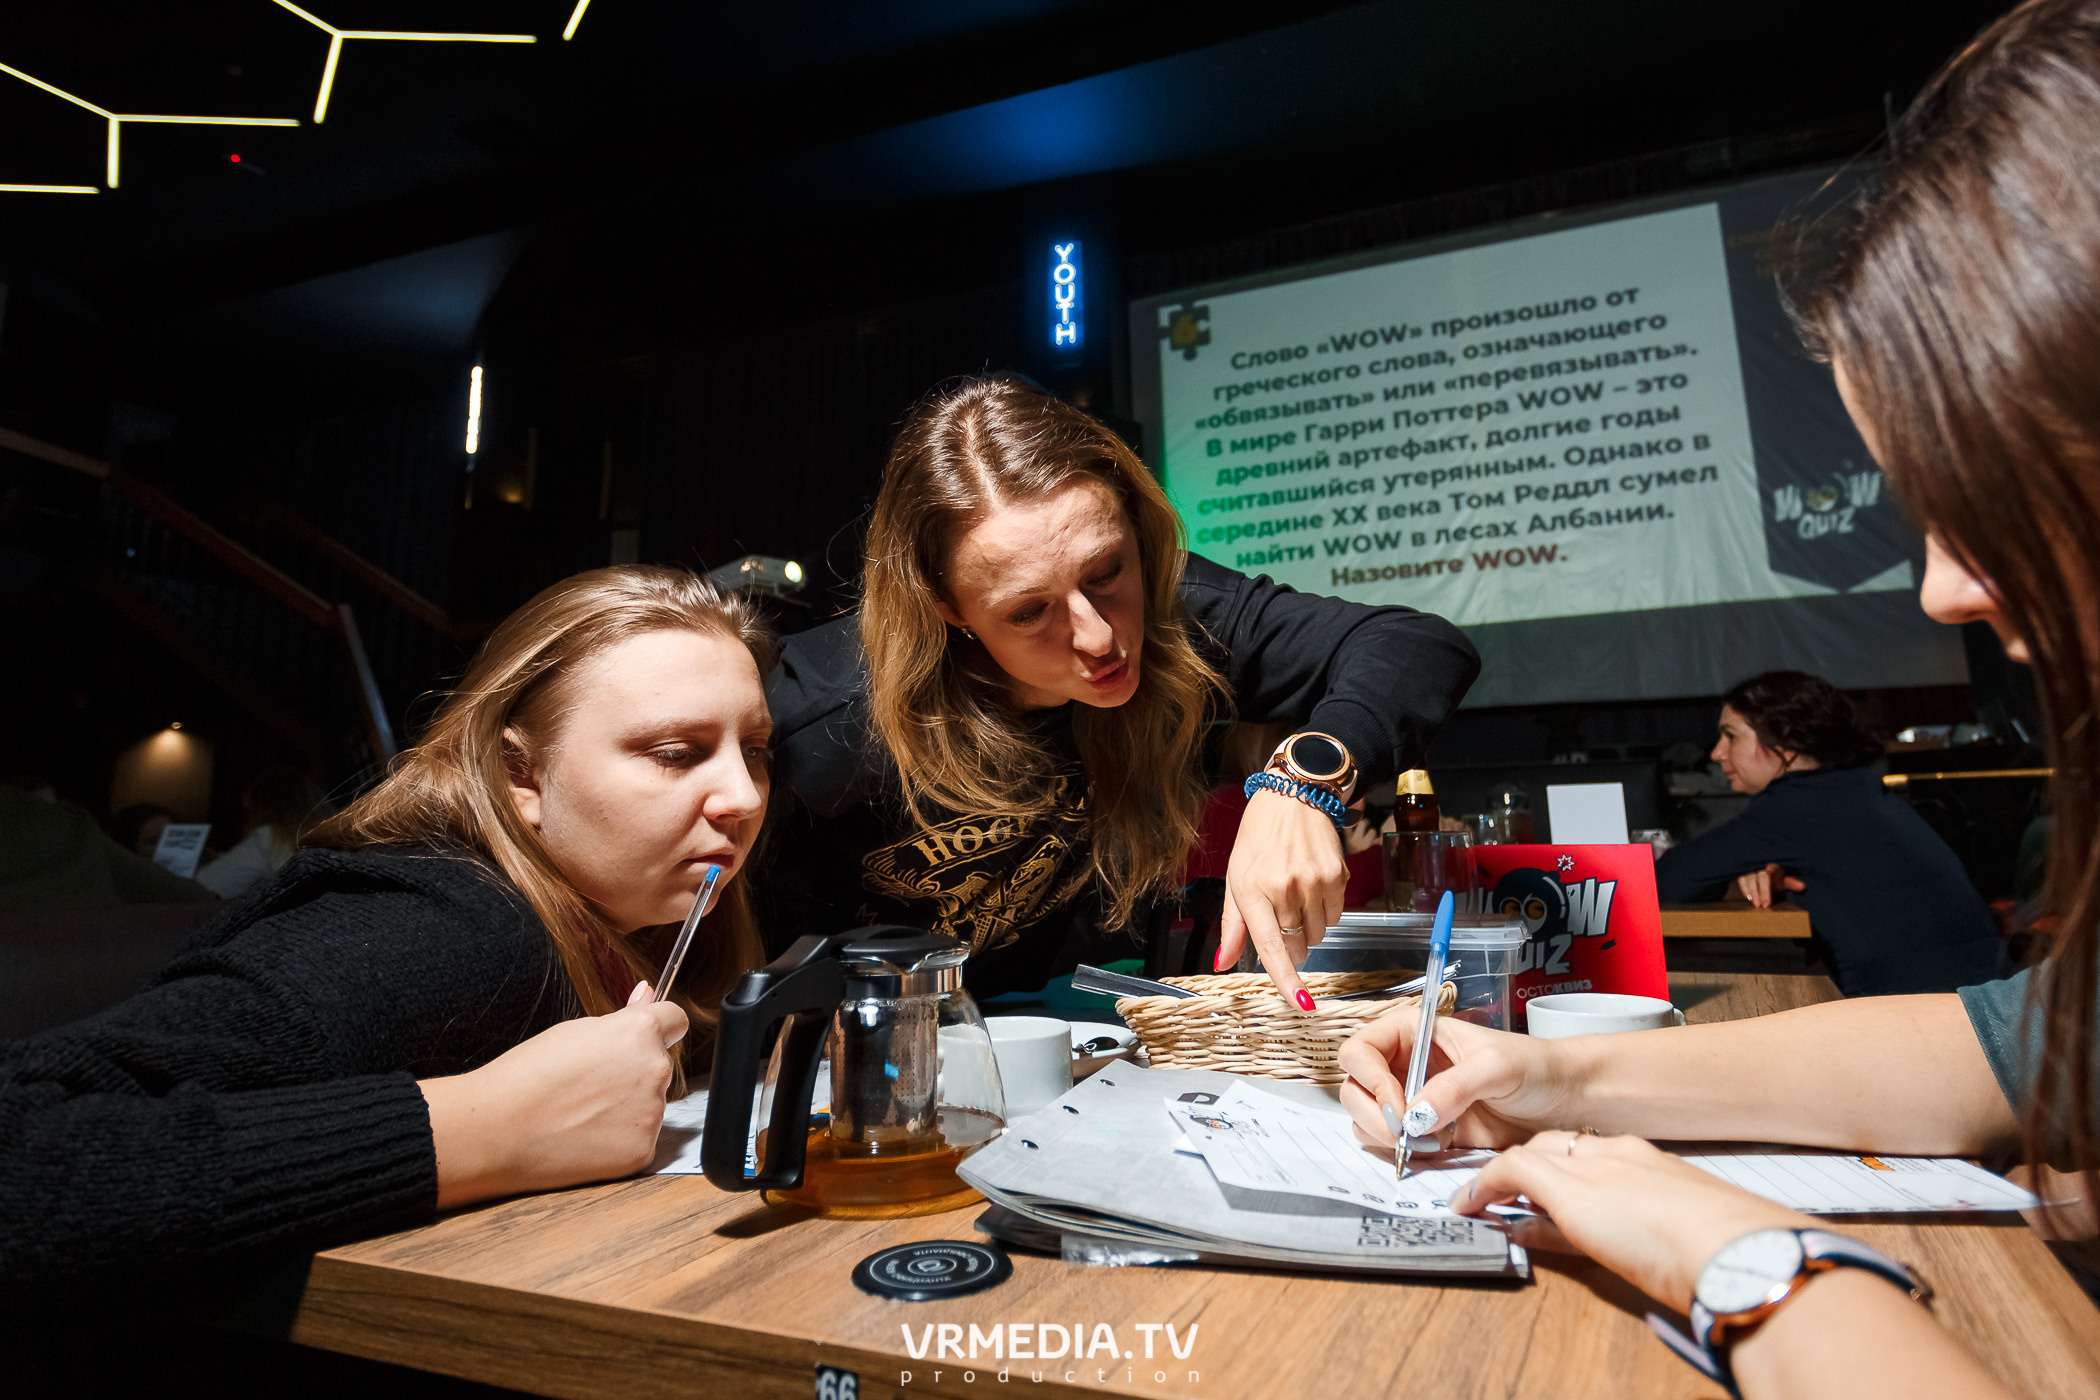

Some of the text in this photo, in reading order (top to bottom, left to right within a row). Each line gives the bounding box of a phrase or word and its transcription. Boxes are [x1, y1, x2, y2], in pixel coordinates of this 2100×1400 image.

[1053, 243, 1077, 345] YOUTH
[1231, 286, 1640, 370] Слово «WOW» произошло от
[1195, 341, 1698, 430] «обвязывать» или «перевязывать».
[1213, 314, 1667, 402] греческого слова, означающего
[1206, 439, 1222, 458] В
[1230, 429, 1297, 456] мире
[1305, 415, 1385, 446] Гарри
[1393, 398, 1509, 430] Поттера
[1518, 381, 1604, 411] WOW
[1636, 372, 1688, 395] это
[1215, 406, 1680, 486] древний артефакт, долгие годы
[1196, 513, 1323, 545] середине
[1377, 499, 1440, 521] века
[1447, 486, 1505, 513] Том
[1514, 478, 1610, 506] Реддл
[1619, 464, 1719, 497] сумел
[1197, 434, 1711, 515] считавшийся утерянным. Однако в
[1236, 503, 1675, 568] найти WOW в лесах Албании.
[1798, 506, 1854, 539] QUIZ
[1331, 544, 1568, 587] Назовите WOW.
[1515, 934, 1573, 976] UIZ
[1516, 979, 1592, 999] ОСТОКВИЗ
